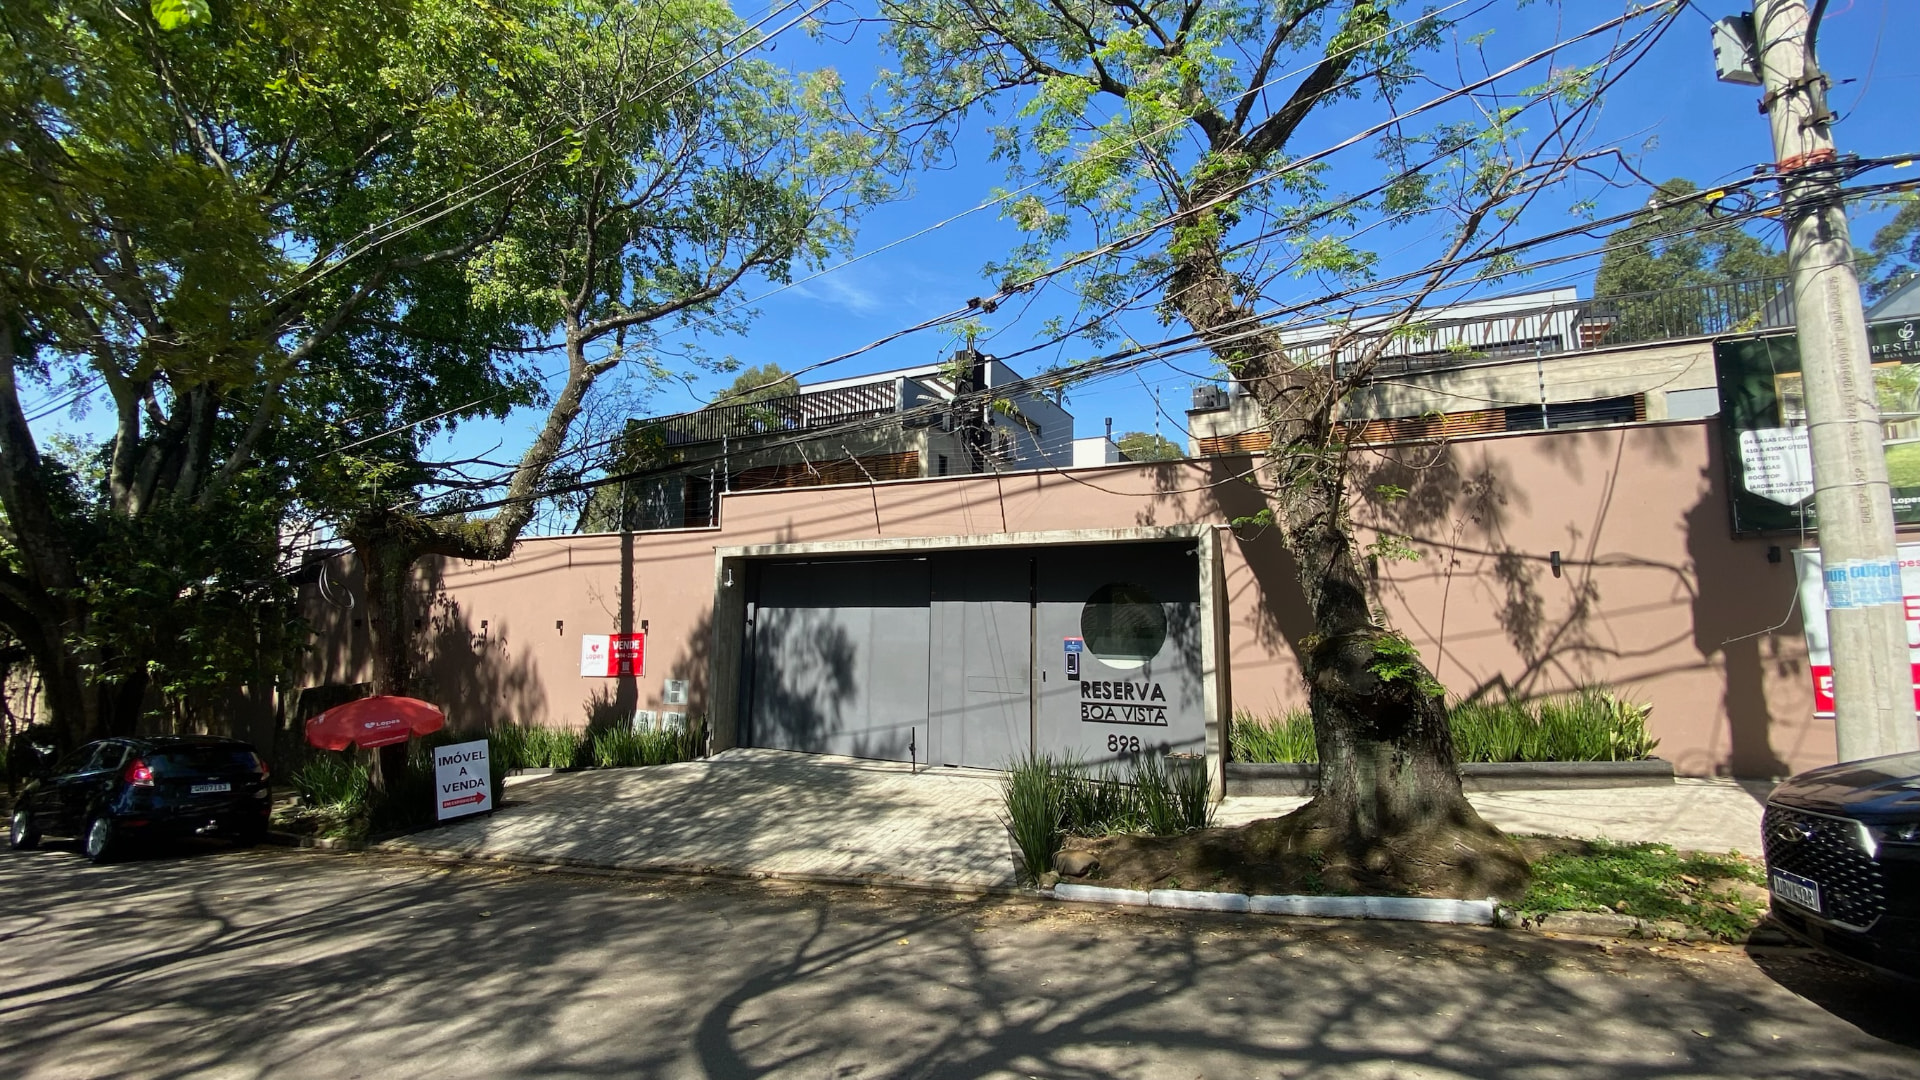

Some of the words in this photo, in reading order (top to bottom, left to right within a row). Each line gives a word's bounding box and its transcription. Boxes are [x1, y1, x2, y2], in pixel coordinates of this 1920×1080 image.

[612, 640, 640, 650] VENDE
[1080, 680, 1166, 702] RESERVA
[1081, 704, 1117, 721] BOA
[1121, 706, 1168, 724] VISTA
[376, 719, 401, 727] Lopes
[1107, 734, 1141, 753] 898
[438, 751, 487, 767] IMÓVEL
[459, 766, 468, 777] A
[442, 778, 486, 794] VENDA
